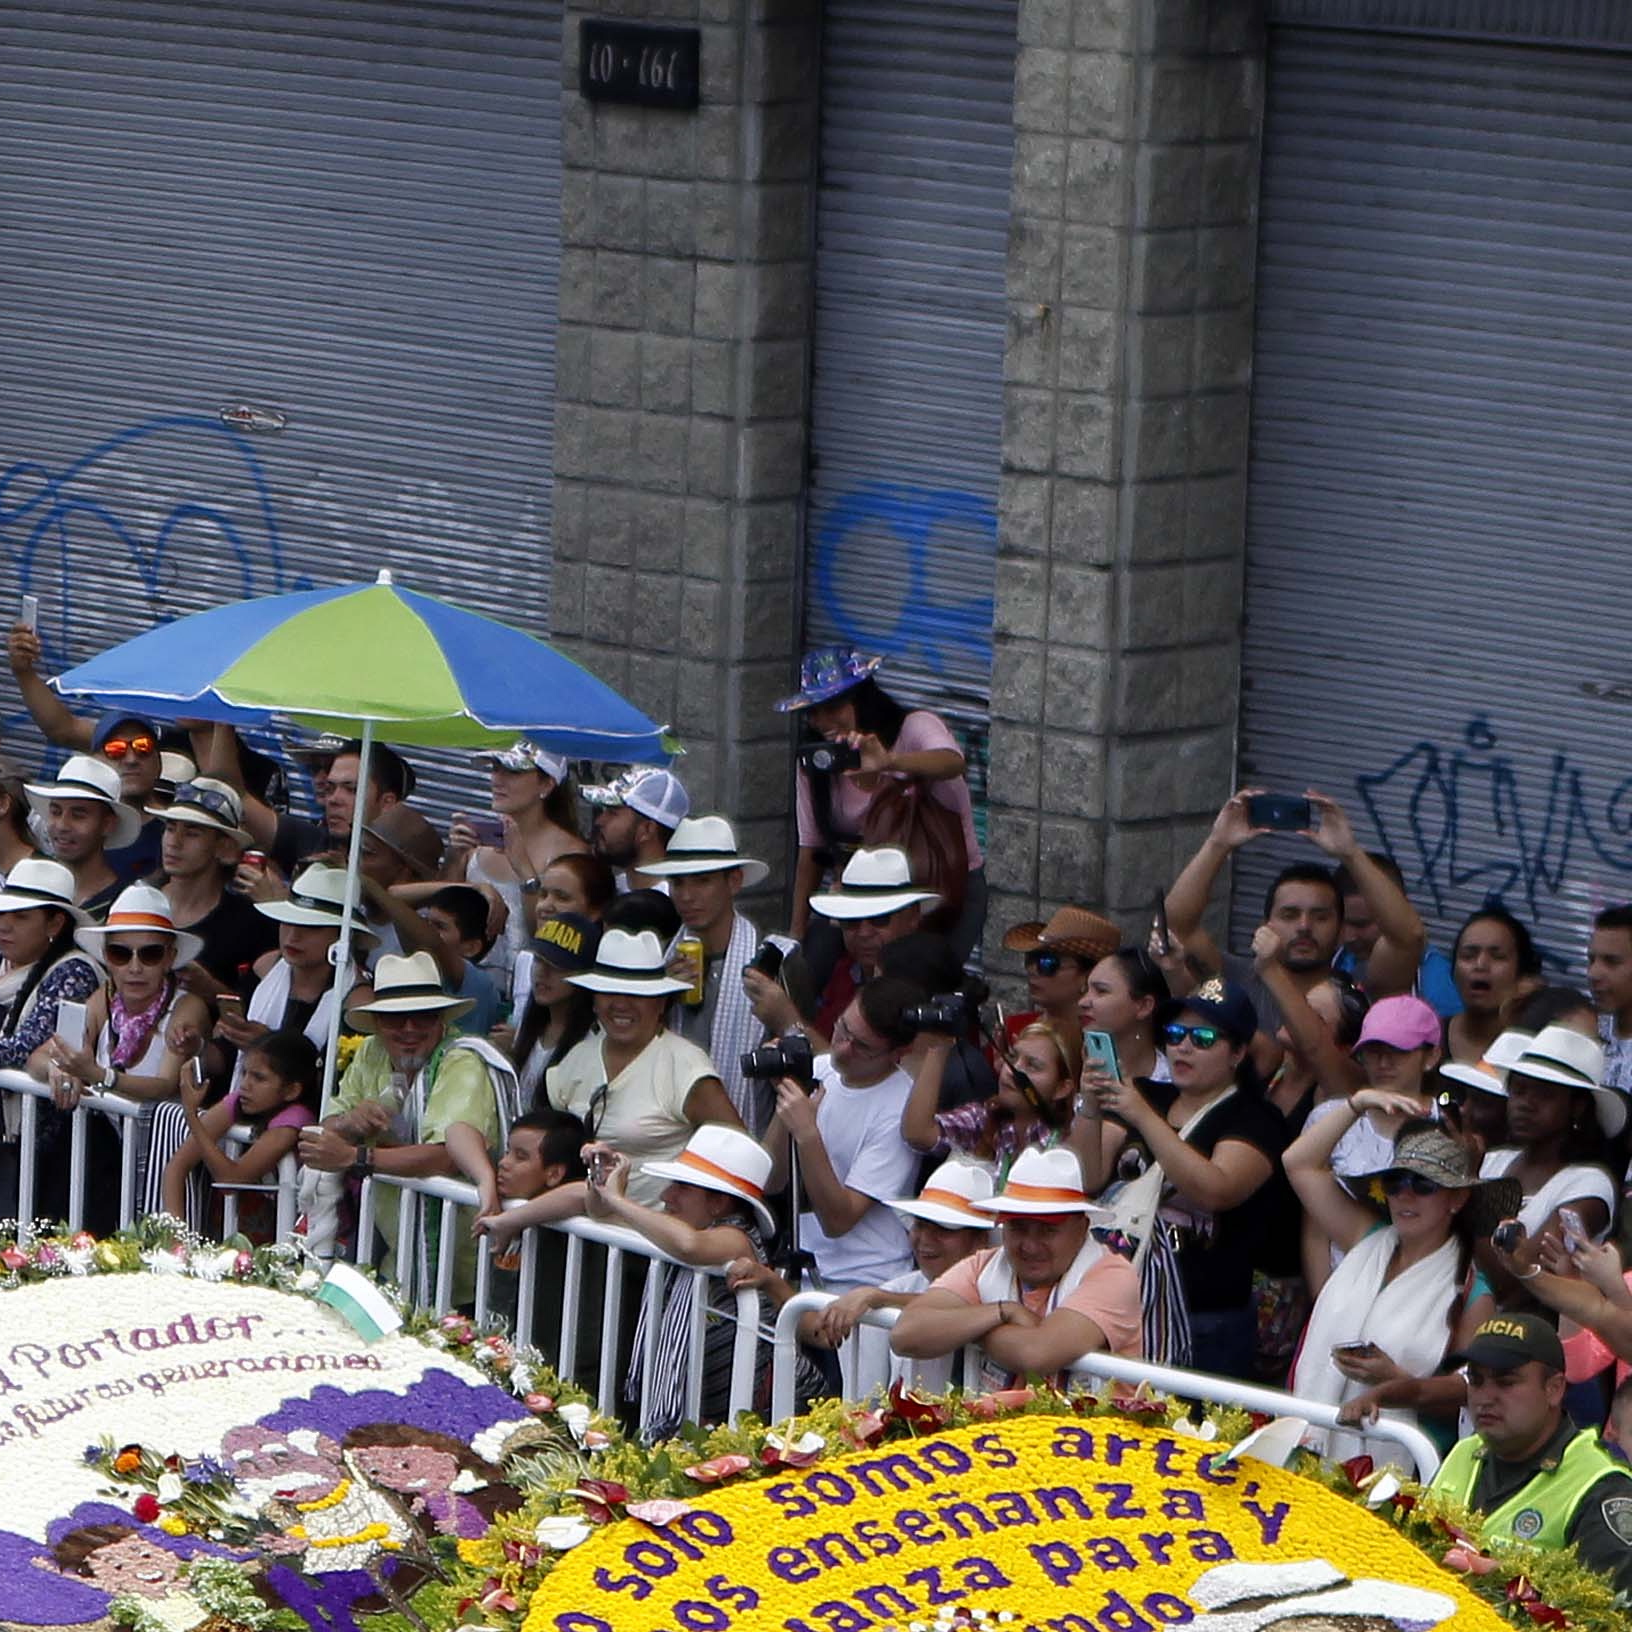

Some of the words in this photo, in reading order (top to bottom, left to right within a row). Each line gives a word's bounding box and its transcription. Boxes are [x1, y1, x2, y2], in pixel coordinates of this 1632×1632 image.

[136, 1352, 382, 1399] generaciones
[593, 1508, 735, 1601] solo
[765, 1433, 1018, 1521] somos
[767, 1481, 1208, 1586] enseñanza
[1242, 1500, 1292, 1545] y
[1027, 1528, 1235, 1588] para
